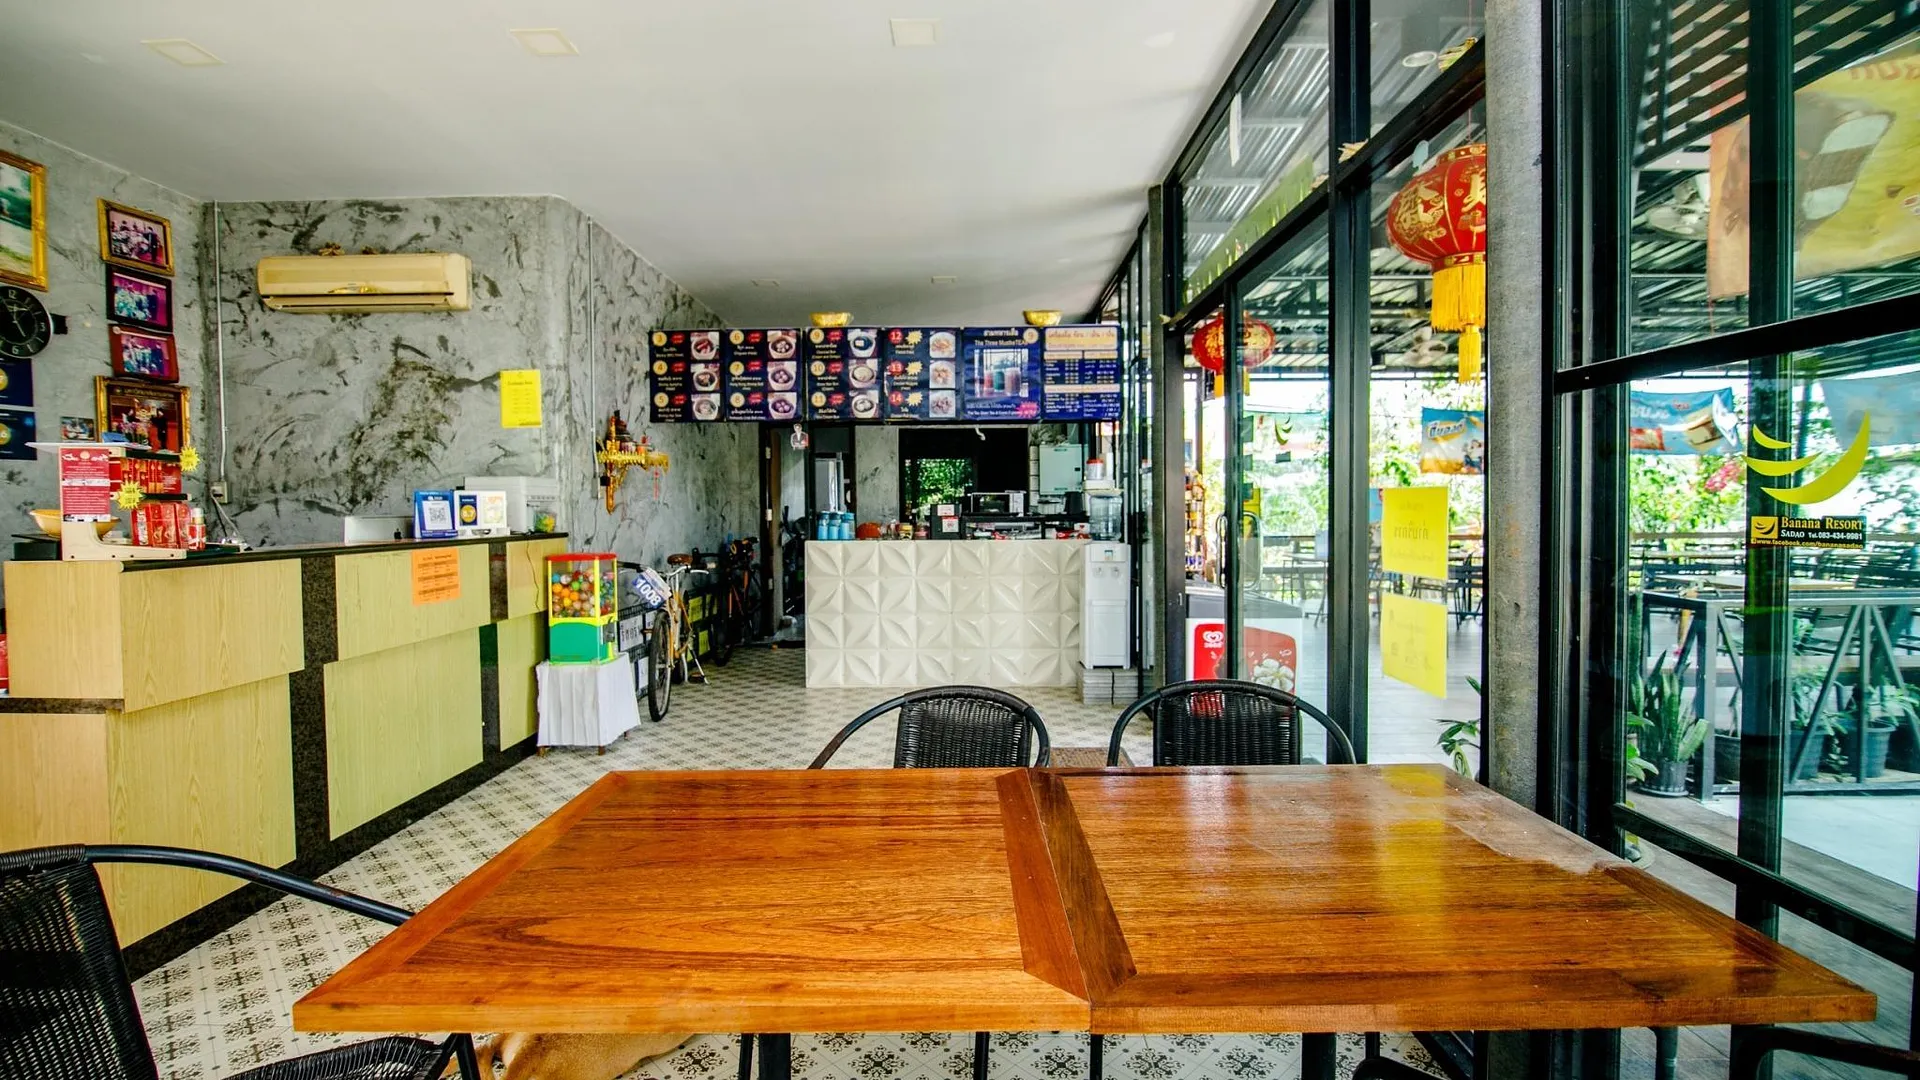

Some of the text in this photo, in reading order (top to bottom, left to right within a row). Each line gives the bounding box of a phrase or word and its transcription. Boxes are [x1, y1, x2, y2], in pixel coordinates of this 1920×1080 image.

[891, 331, 901, 339] 12
[891, 395, 901, 403] 14
[1781, 516, 1863, 530] Banana RESORT
[1781, 529, 1805, 538] SADAO
[635, 579, 662, 606] 1008
